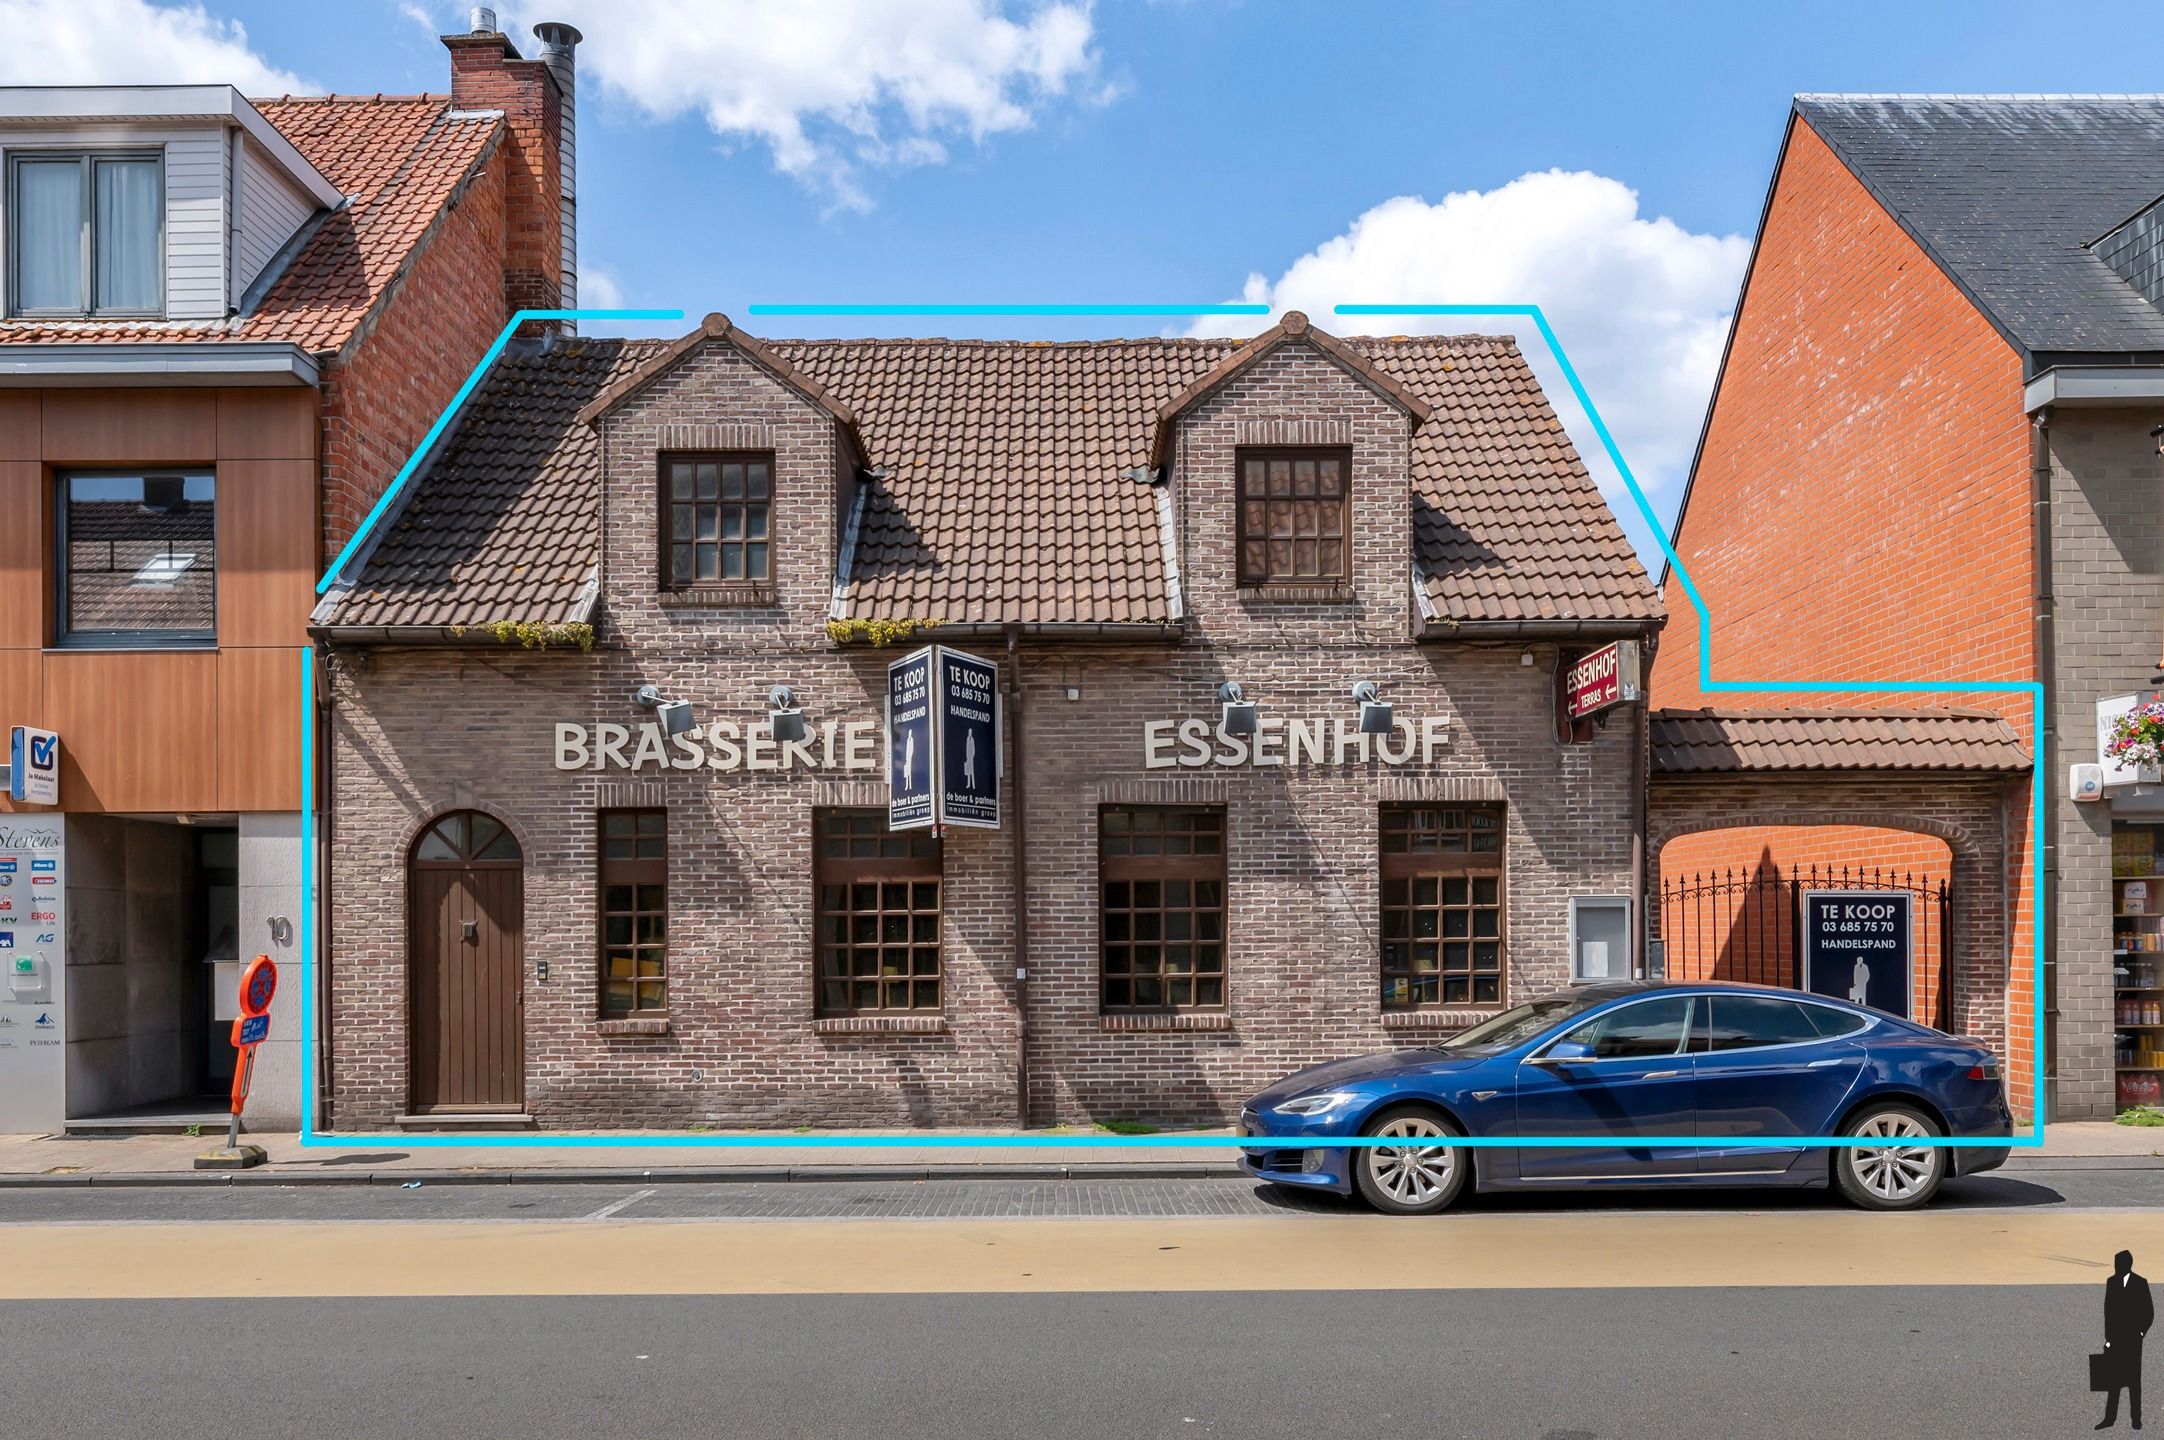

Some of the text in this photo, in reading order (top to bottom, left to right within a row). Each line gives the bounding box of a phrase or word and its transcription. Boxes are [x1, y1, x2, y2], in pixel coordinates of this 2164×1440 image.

[894, 666, 925, 692] TE KOOP
[949, 665, 990, 690] TE KOOP
[1567, 649, 1616, 695] ESSENHOF
[894, 686, 926, 706] 03 685 75 70
[951, 685, 990, 705] 03 685 75 70
[1581, 688, 1602, 709] TERRAS
[893, 705, 926, 724] HANDELSPAND
[950, 704, 990, 723] HANDELSPAND
[555, 720, 876, 771] BRASSERIE
[1144, 716, 1451, 769] ESSENHOF
[892, 798, 898, 808] de
[898, 795, 907, 807] boer
[911, 793, 930, 806] partners
[946, 792, 996, 806] de boer & partners
[31, 911, 56, 920] ERGO
[1821, 904, 1896, 919] TE KOOP
[265, 915, 289, 942] 10
[1822, 921, 1894, 932] 03 685 75 70
[36, 933, 55, 943] AG
[1821, 939, 1896, 949] HANDELSPAND
